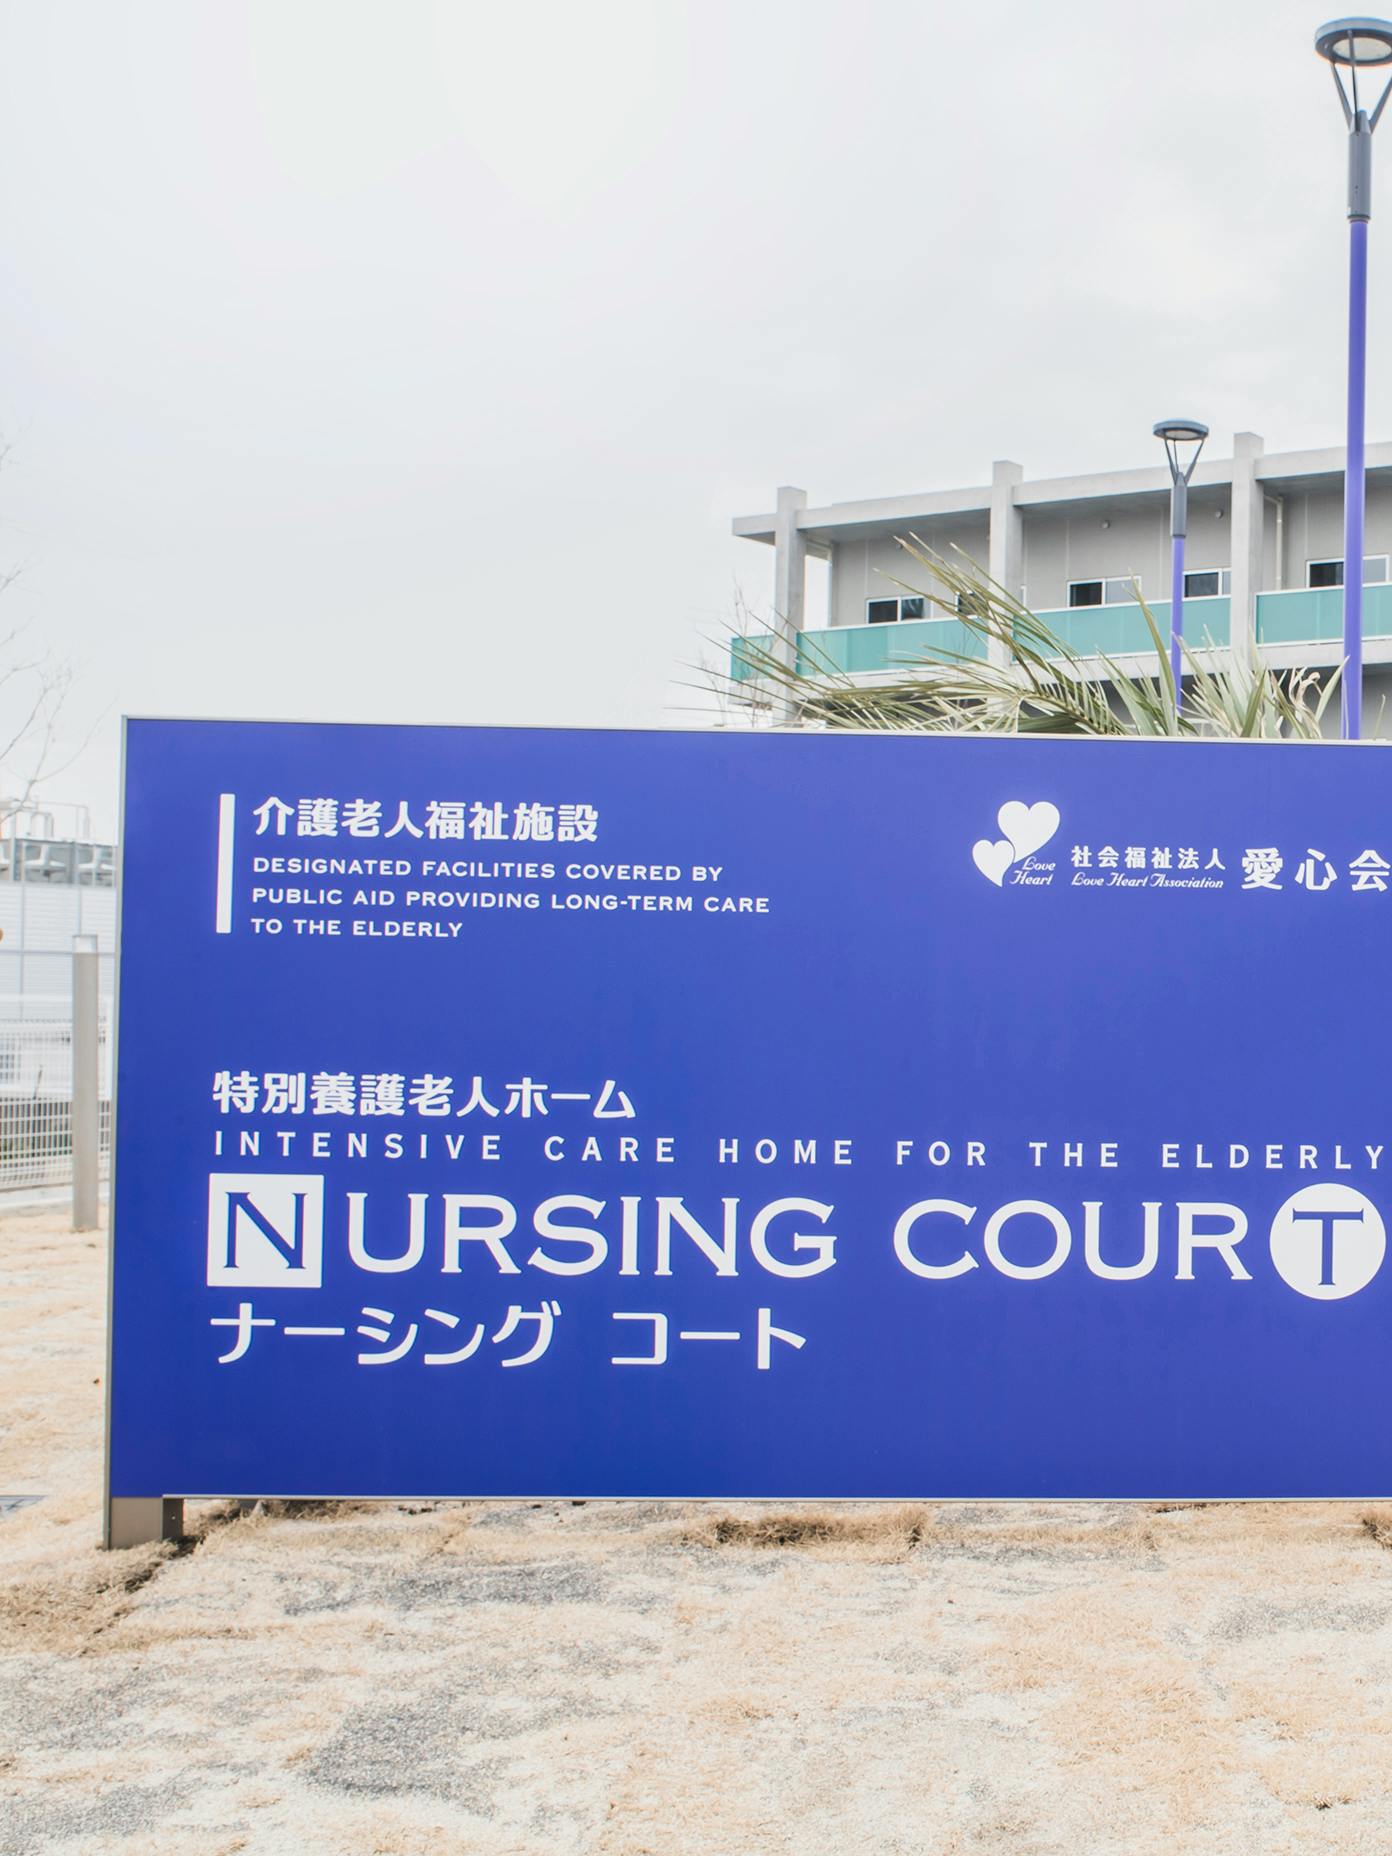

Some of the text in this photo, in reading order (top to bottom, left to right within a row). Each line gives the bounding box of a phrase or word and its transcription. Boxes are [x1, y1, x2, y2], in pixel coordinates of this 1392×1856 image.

[252, 796, 599, 842] 介護老人福祉施設
[253, 857, 723, 882] DESIGNATED FACILITIES COVERED BY
[1022, 856, 1056, 872] Love
[1070, 845, 1226, 870] 社会福祉法人
[1241, 847, 1391, 892] 愛心会
[1009, 870, 1054, 886] Heart
[1071, 871, 1224, 889] Love Heart Association
[252, 887, 770, 913] PUBLIC AID PROVIDING LONG-TERM CARE
[250, 918, 463, 938] TO THE ELDERLY
[212, 1070, 636, 1119] 特別養護老人ホーム
[214, 1130, 1385, 1170] INTENSIVE CARE HOME FOR THE ELDERLY
[207, 1173, 1387, 1300] NURSING COURT
[210, 1300, 807, 1370] ナーシング コート
